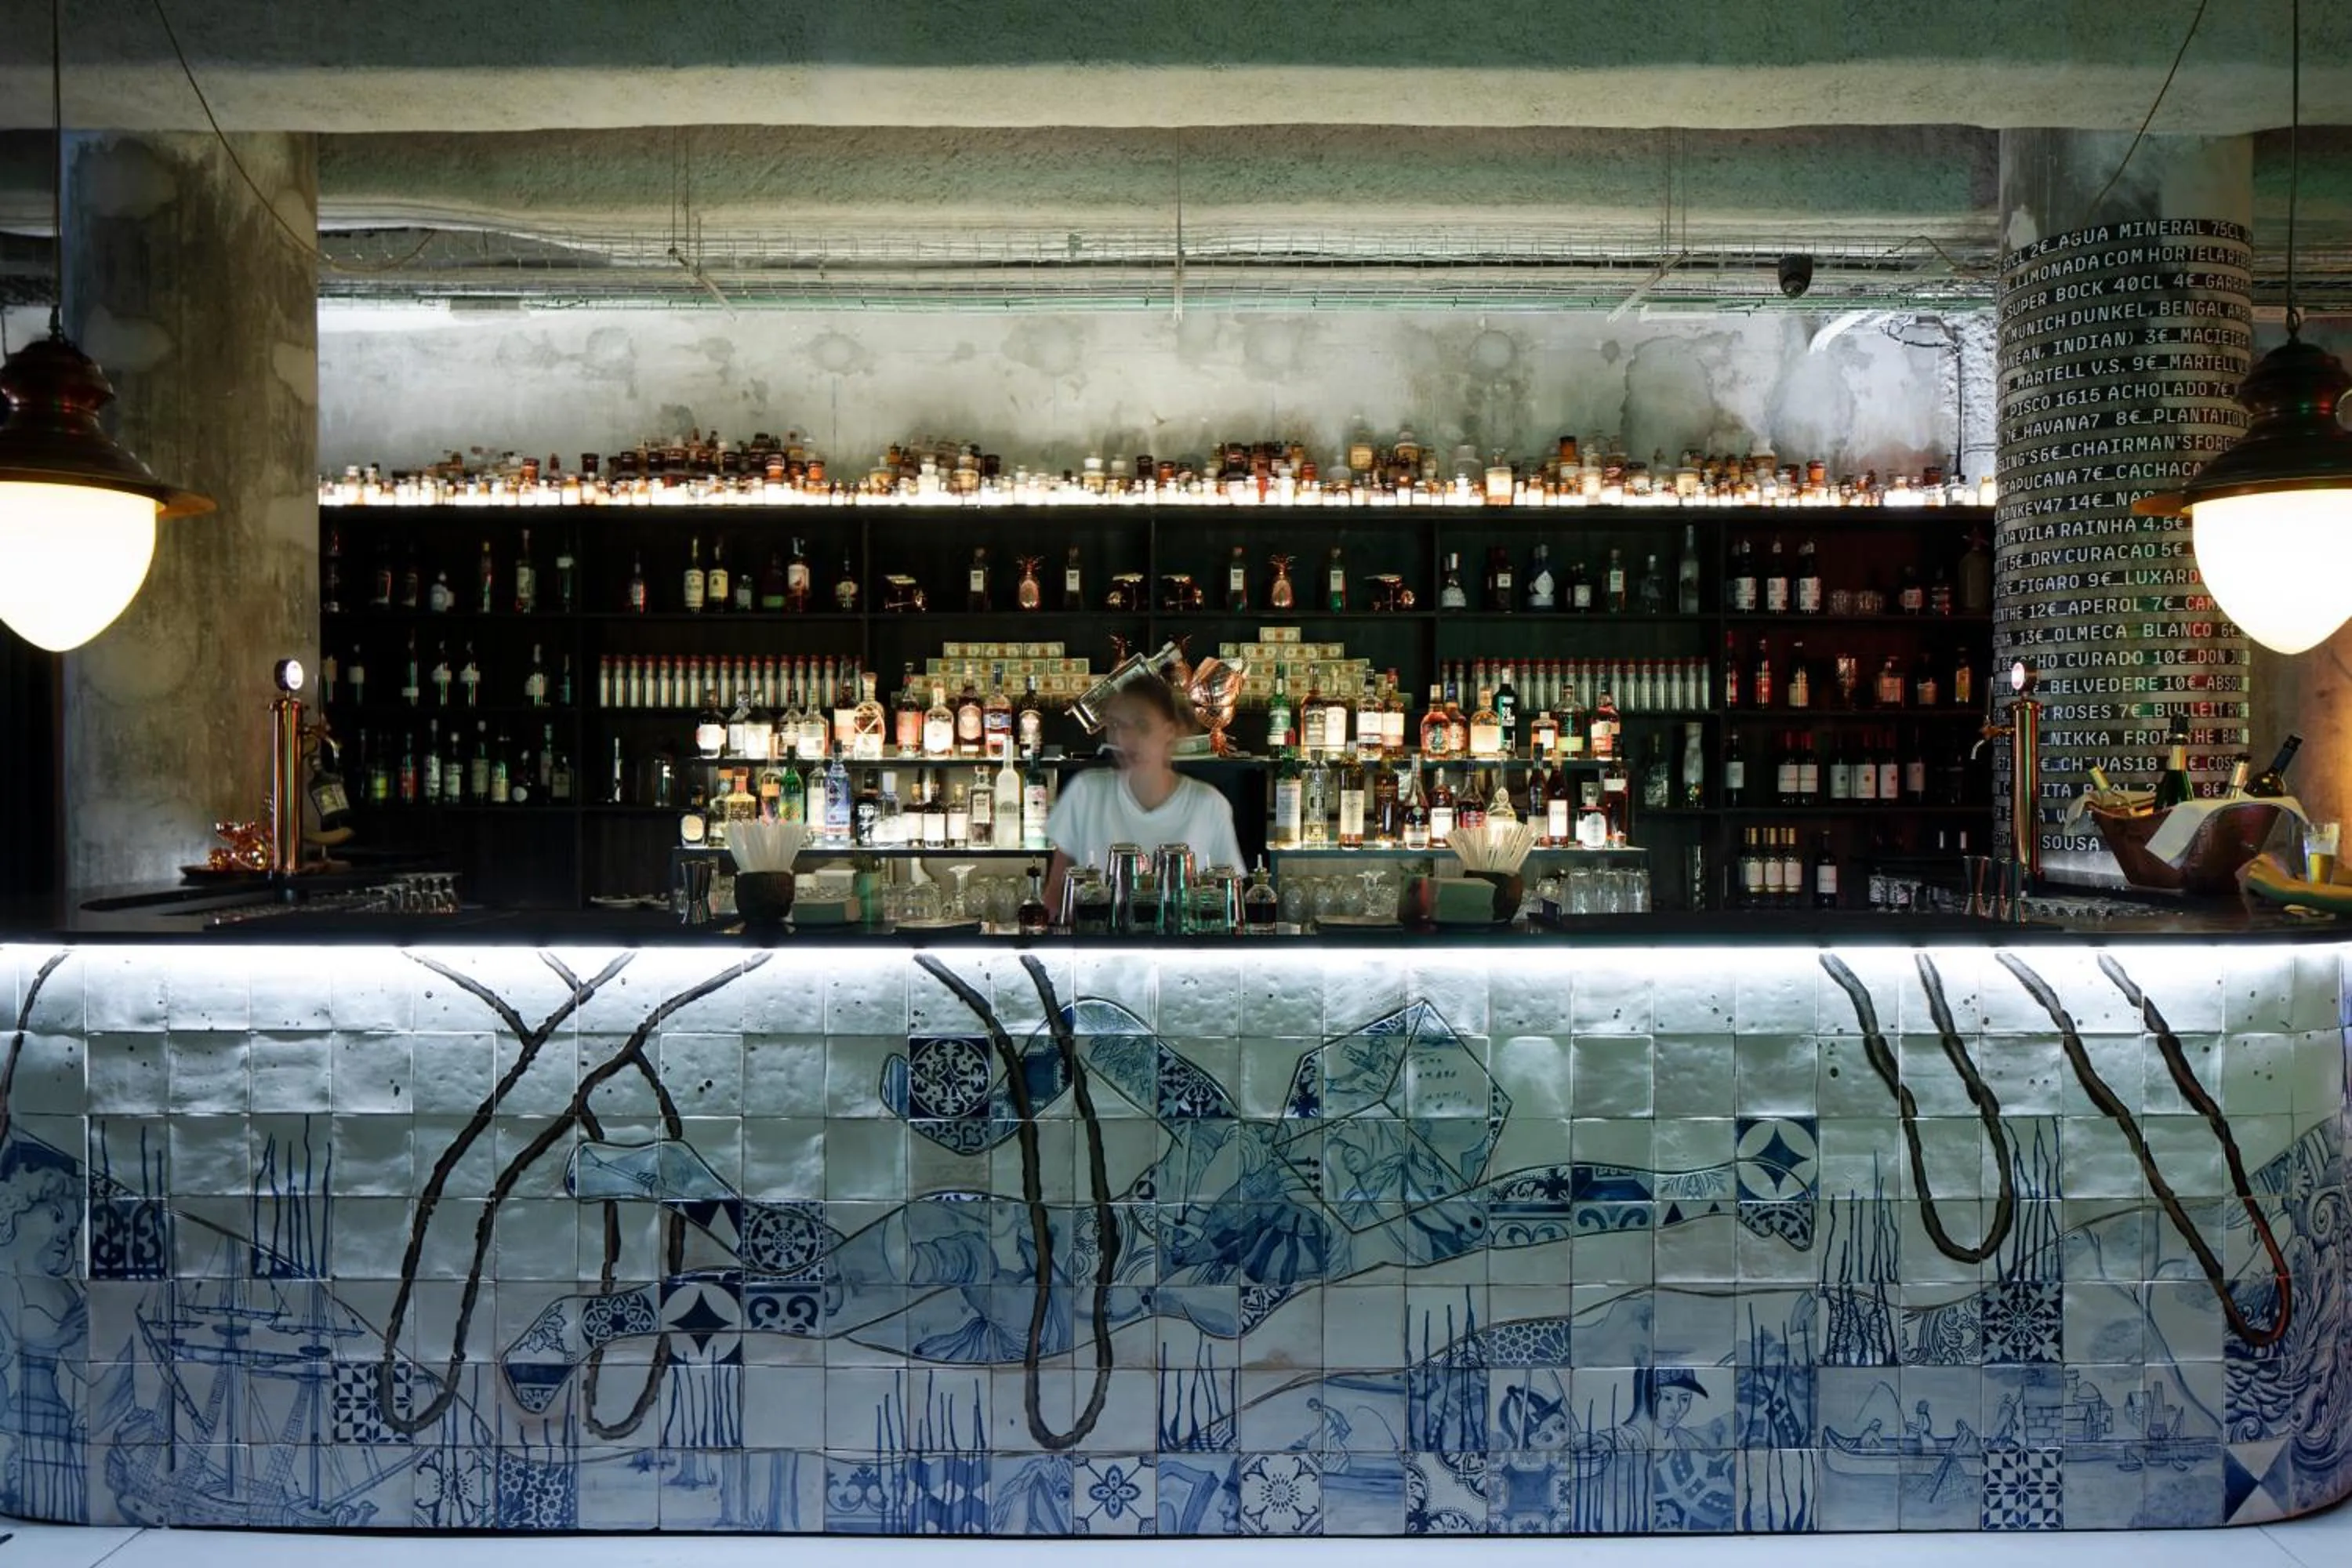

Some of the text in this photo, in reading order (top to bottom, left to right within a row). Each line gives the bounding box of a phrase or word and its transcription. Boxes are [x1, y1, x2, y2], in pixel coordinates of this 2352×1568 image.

[2118, 220, 2205, 240] MINERAL
[2212, 222, 2241, 239] 75CL
[2104, 248, 2143, 267] COM
[2056, 281, 2104, 303] BOCK
[2114, 275, 2164, 292] 40CL
[2071, 303, 2154, 326] DUNKEL,
[2160, 300, 2225, 318] BENGAL
[2053, 330, 2134, 357] INDIAN)
[2091, 358, 2126, 376] V.S.
[2056, 387, 2101, 408] 1615
[2107, 381, 2209, 401] ACHOLADO
[2019, 524, 2055, 543] VILA
[2060, 517, 2137, 538] RAINHA
[2066, 543, 2155, 563] CURACAO
[2143, 622, 2212, 638] BLANCO
[2066, 650, 2143, 667] CURADO
[2053, 704, 2111, 720] ROSES
[2042, 835, 2101, 851] SOUSA
